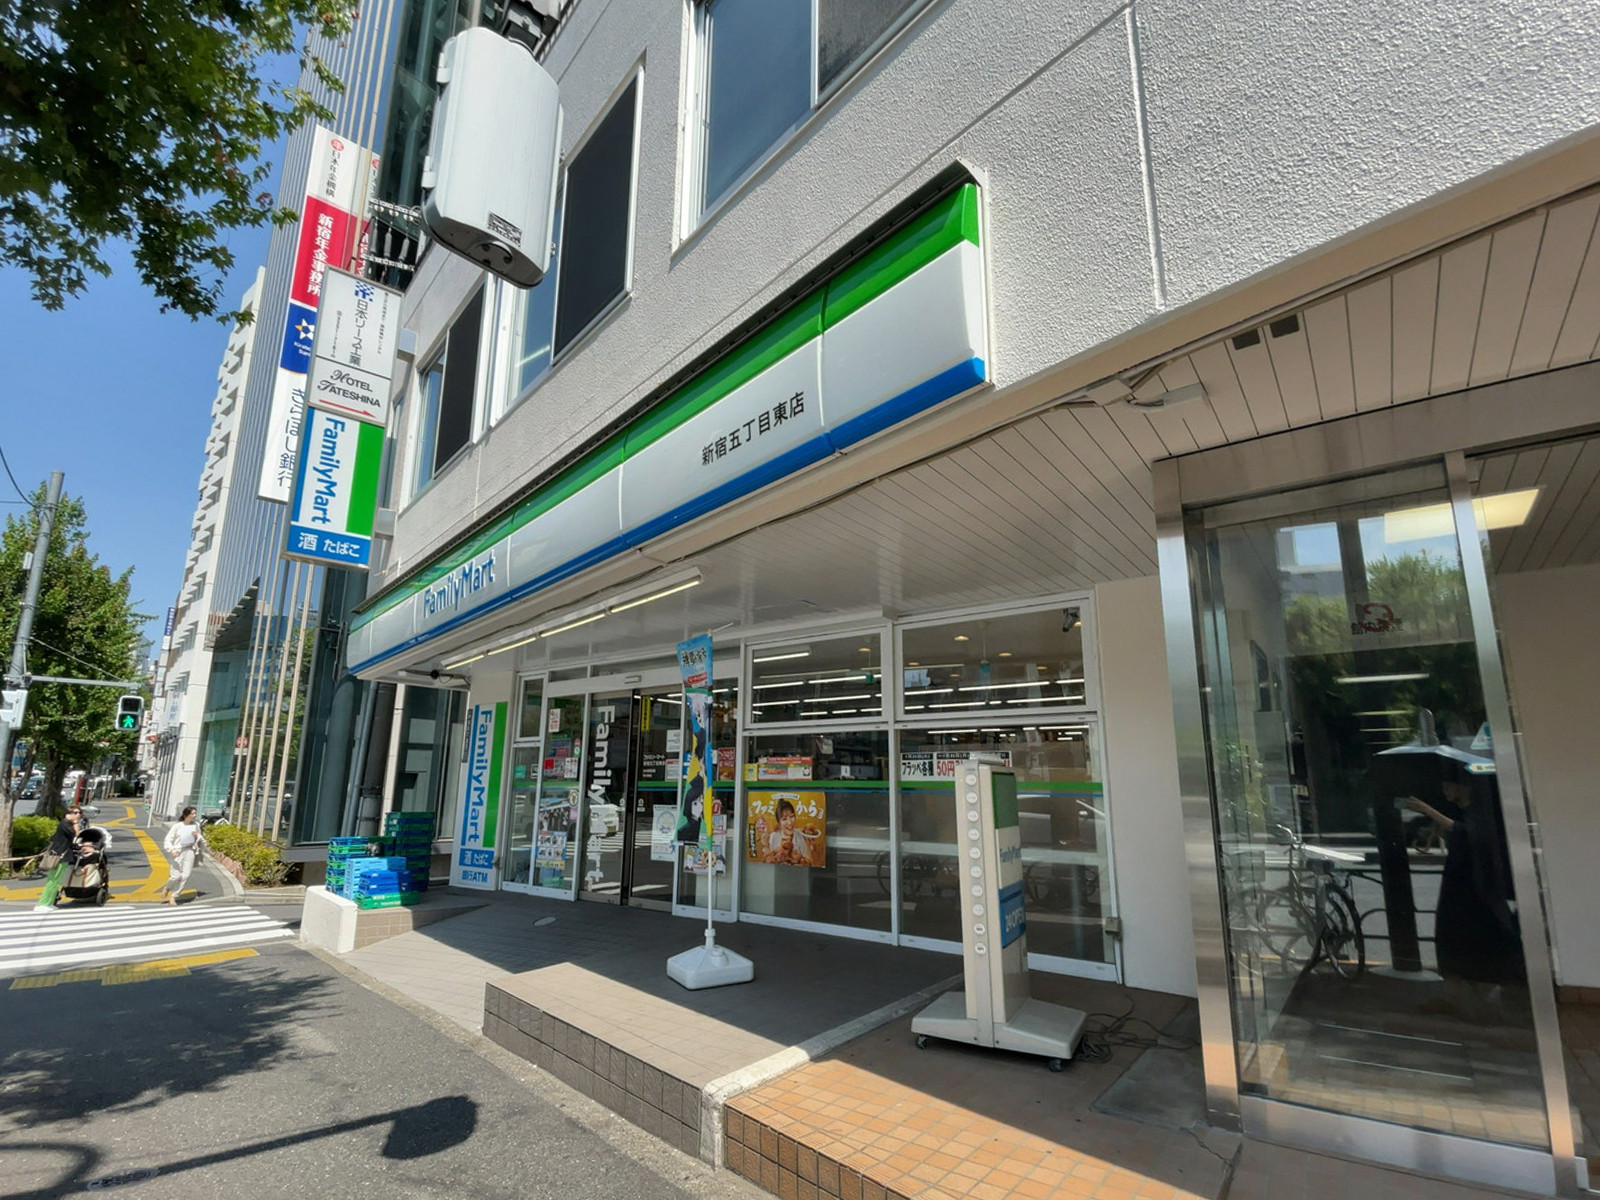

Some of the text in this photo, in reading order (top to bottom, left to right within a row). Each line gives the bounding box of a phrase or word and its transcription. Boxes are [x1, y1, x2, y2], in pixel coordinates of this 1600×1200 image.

[307, 213, 334, 297] 新宿年金事務所
[349, 299, 369, 367] 日本リース工業
[317, 379, 382, 408] TATESHINA
[330, 369, 374, 393] HOTEL
[701, 391, 805, 466] 新宿五丁目東店
[311, 417, 346, 524] FamilyMart
[298, 532, 360, 558] 酒 たばこ
[424, 549, 497, 619] FamilyMart
[468, 709, 493, 843] FamilyMart
